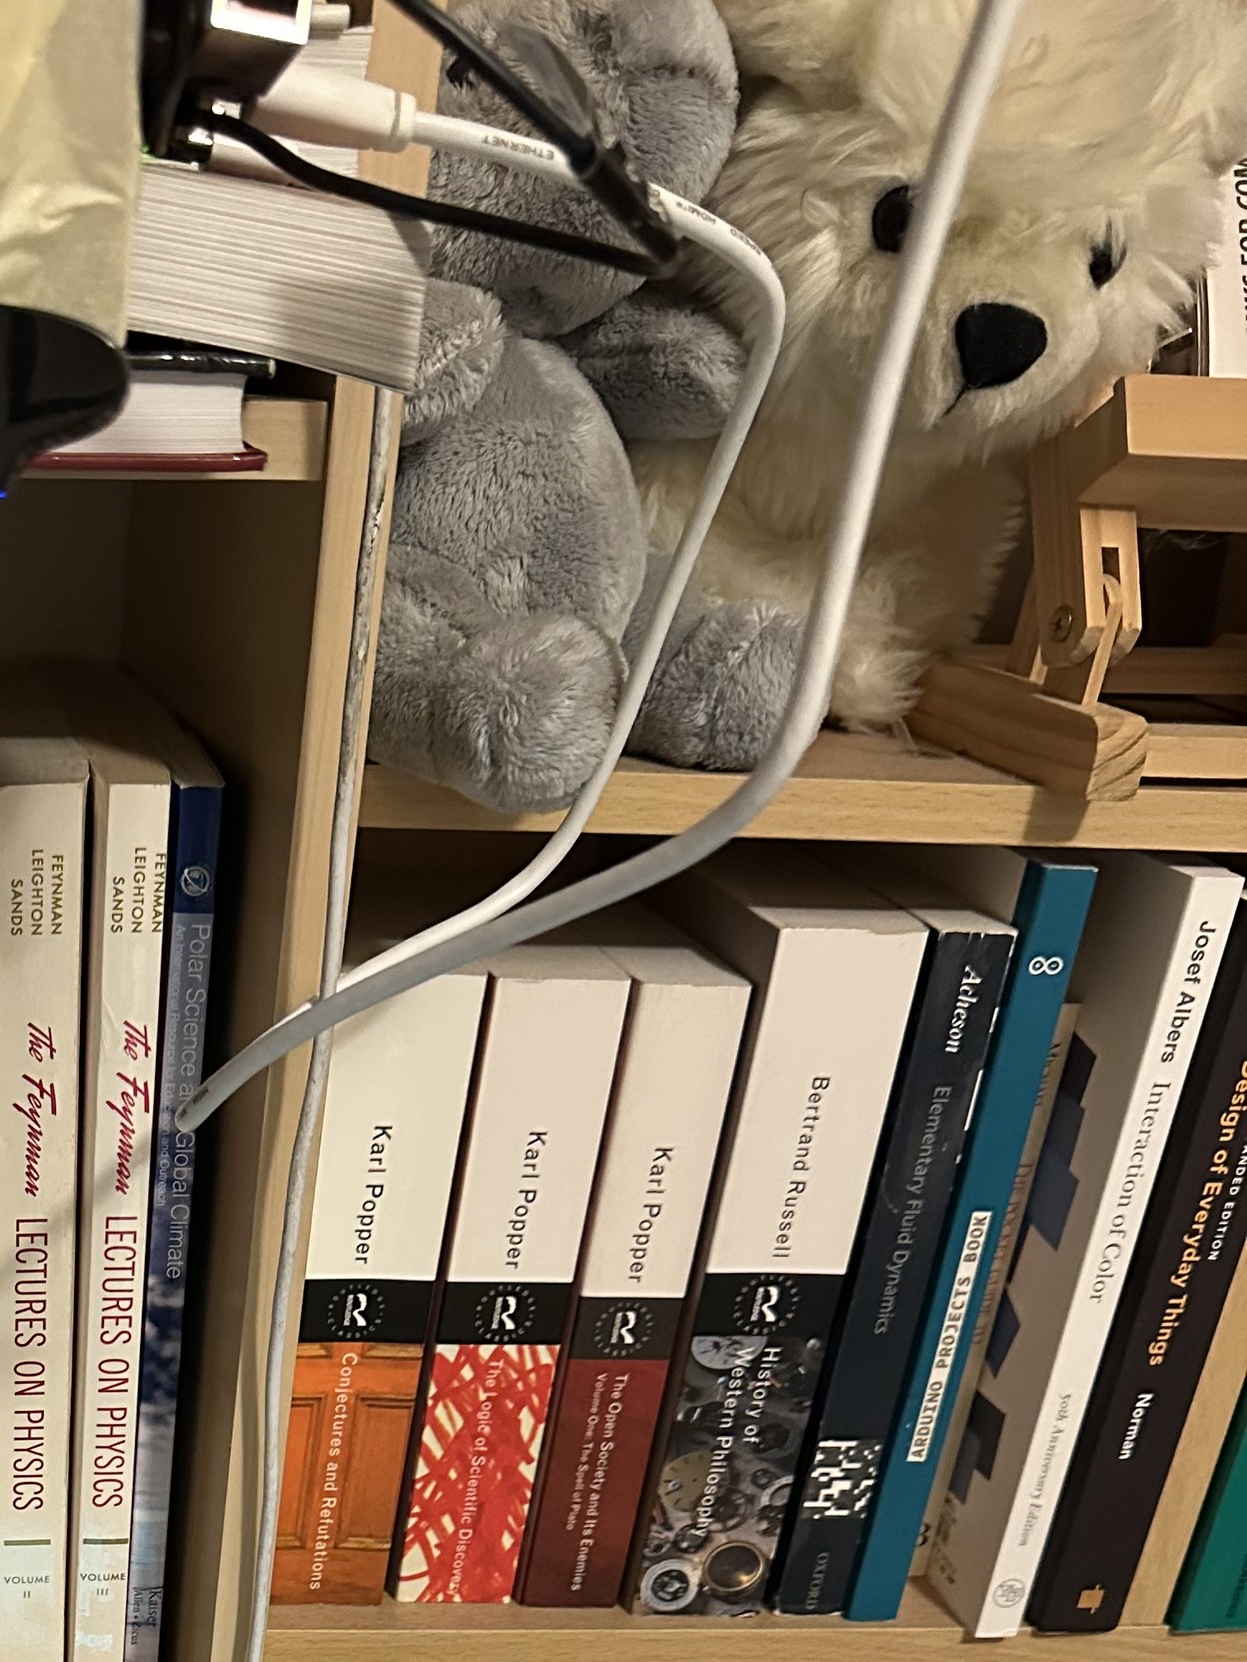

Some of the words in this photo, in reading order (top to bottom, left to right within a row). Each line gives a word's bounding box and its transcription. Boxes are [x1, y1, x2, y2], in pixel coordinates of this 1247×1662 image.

[11, 879, 23, 937] SANDS
[31, 849, 43, 936] LEIGHTON
[52, 855, 64, 936] FEYNMAN
[111, 876, 124, 934] SANDS
[132, 847, 146, 934] LEIGHTON
[152, 852, 167, 933] FEYNMAN
[1186, 920, 1216, 985] Josef
[27, 1022, 56, 1063] The
[123, 1020, 153, 1062] The
[944, 965, 983, 1054] Acheson
[1161, 991, 1196, 1063] Albers
[12, 1073, 57, 1197] Feynman
[106, 1072, 150, 1196] Feynman
[793, 1076, 831, 1172] Bertrand
[906, 1085, 951, 1195] Elementary
[1219, 1061, 1247, 1142] Design
[368, 1124, 393, 1174] Karl
[521, 1130, 547, 1180] Karl
[647, 1147, 673, 1196] Karl
[1118, 1081, 1171, 1209] Interaction
[1210, 1150, 1228, 1175] of
[355, 1183, 384, 1265] Popper
[505, 1188, 537, 1270] Popper
[629, 1203, 661, 1284] Popper
[772, 1180, 806, 1258] Russell
[895, 1200, 923, 1248] Fluid
[1111, 1214, 1127, 1238] of
[1170, 1182, 1223, 1288] Everyday
[14, 1218, 49, 1350] LECTURES
[100, 1216, 138, 1347] LECTURES
[874, 1248, 911, 1335] Dynamics
[1089, 1235, 1121, 1305] Color
[911, 1380, 942, 1459] ARDUINO
[936, 1274, 970, 1369] PROJECTS
[963, 1213, 989, 1264] BOOK
[1149, 1294, 1186, 1366] Things
[12, 1361, 45, 1396] ON
[97, 1357, 130, 1393] ON
[329, 1352, 358, 1458] Conjectures
[719, 1346, 756, 1430] Western
[751, 1346, 781, 1420] History
[12, 1410, 45, 1511] PHYSICS
[92, 1407, 128, 1509] PHYSICS
[743, 1425, 759, 1443] of
[1119, 1393, 1153, 1460] Norman
[326, 1461, 340, 1490] and
[695, 1435, 734, 1537] Philosophy
[310, 1497, 337, 1590] Refutations
